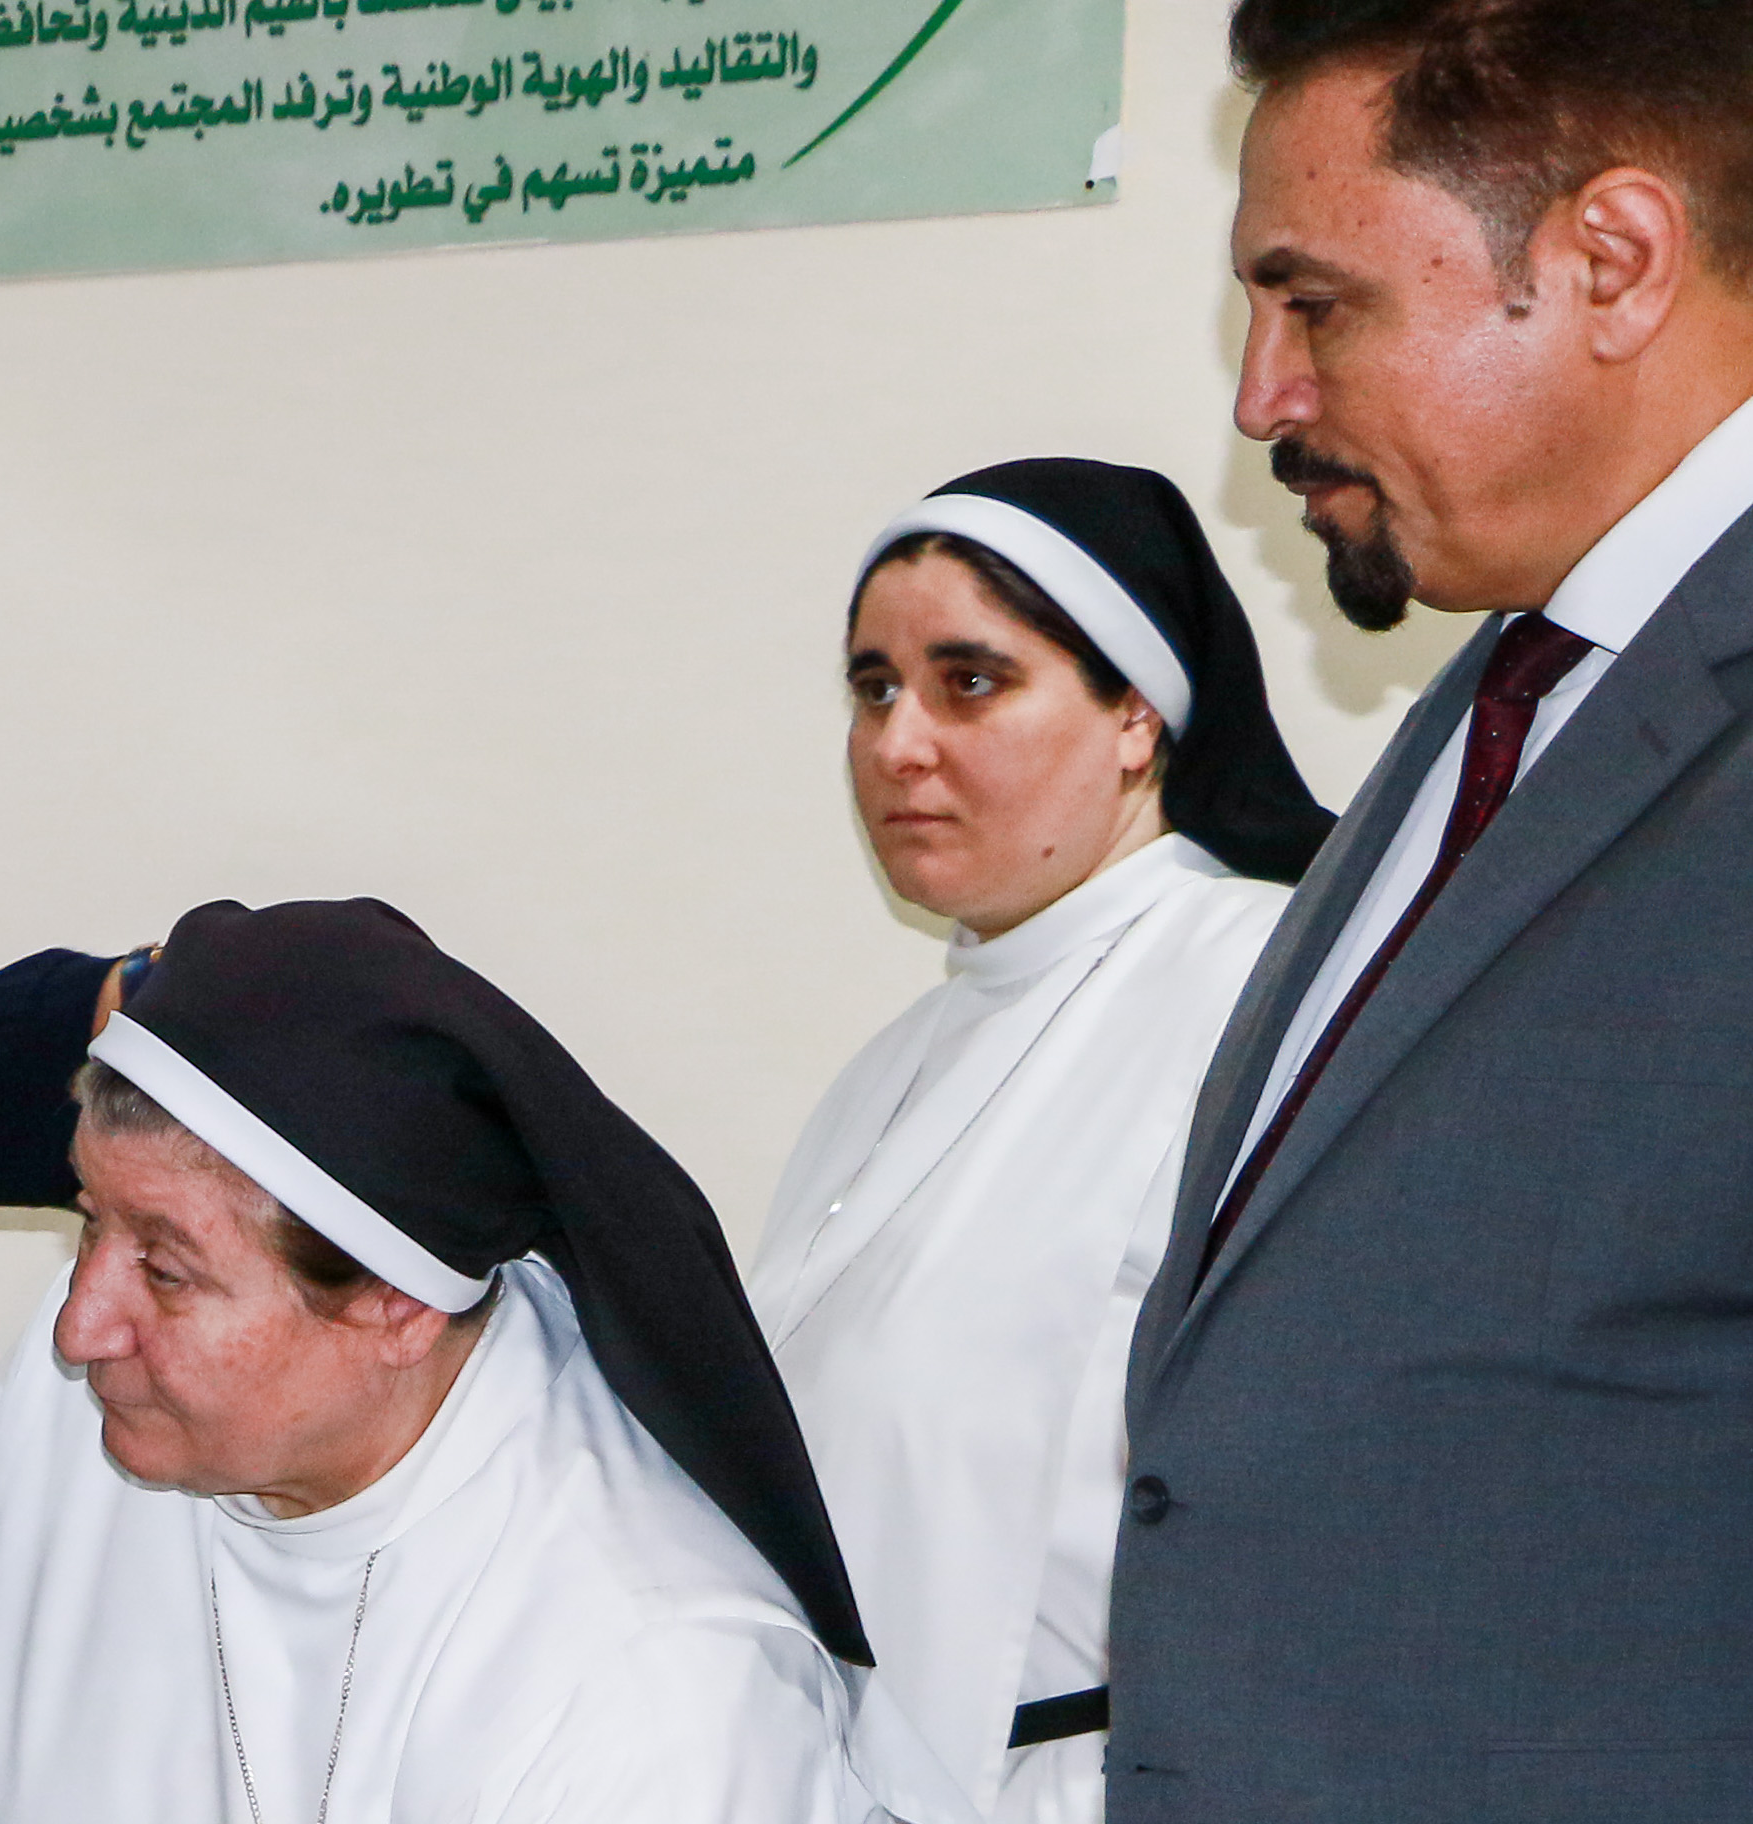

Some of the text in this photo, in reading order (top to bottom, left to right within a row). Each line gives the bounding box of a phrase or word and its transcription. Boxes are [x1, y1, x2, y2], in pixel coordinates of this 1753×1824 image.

[272, 69, 373, 130] وترفد
[381, 55, 512, 123] الوطنية
[522, 45, 650, 112] والهوية
[659, 30, 819, 101] والتقاليد
[125, 77, 264, 150] المجتمع
[319, 136, 756, 225] متميزة تسهم في تطويره.
